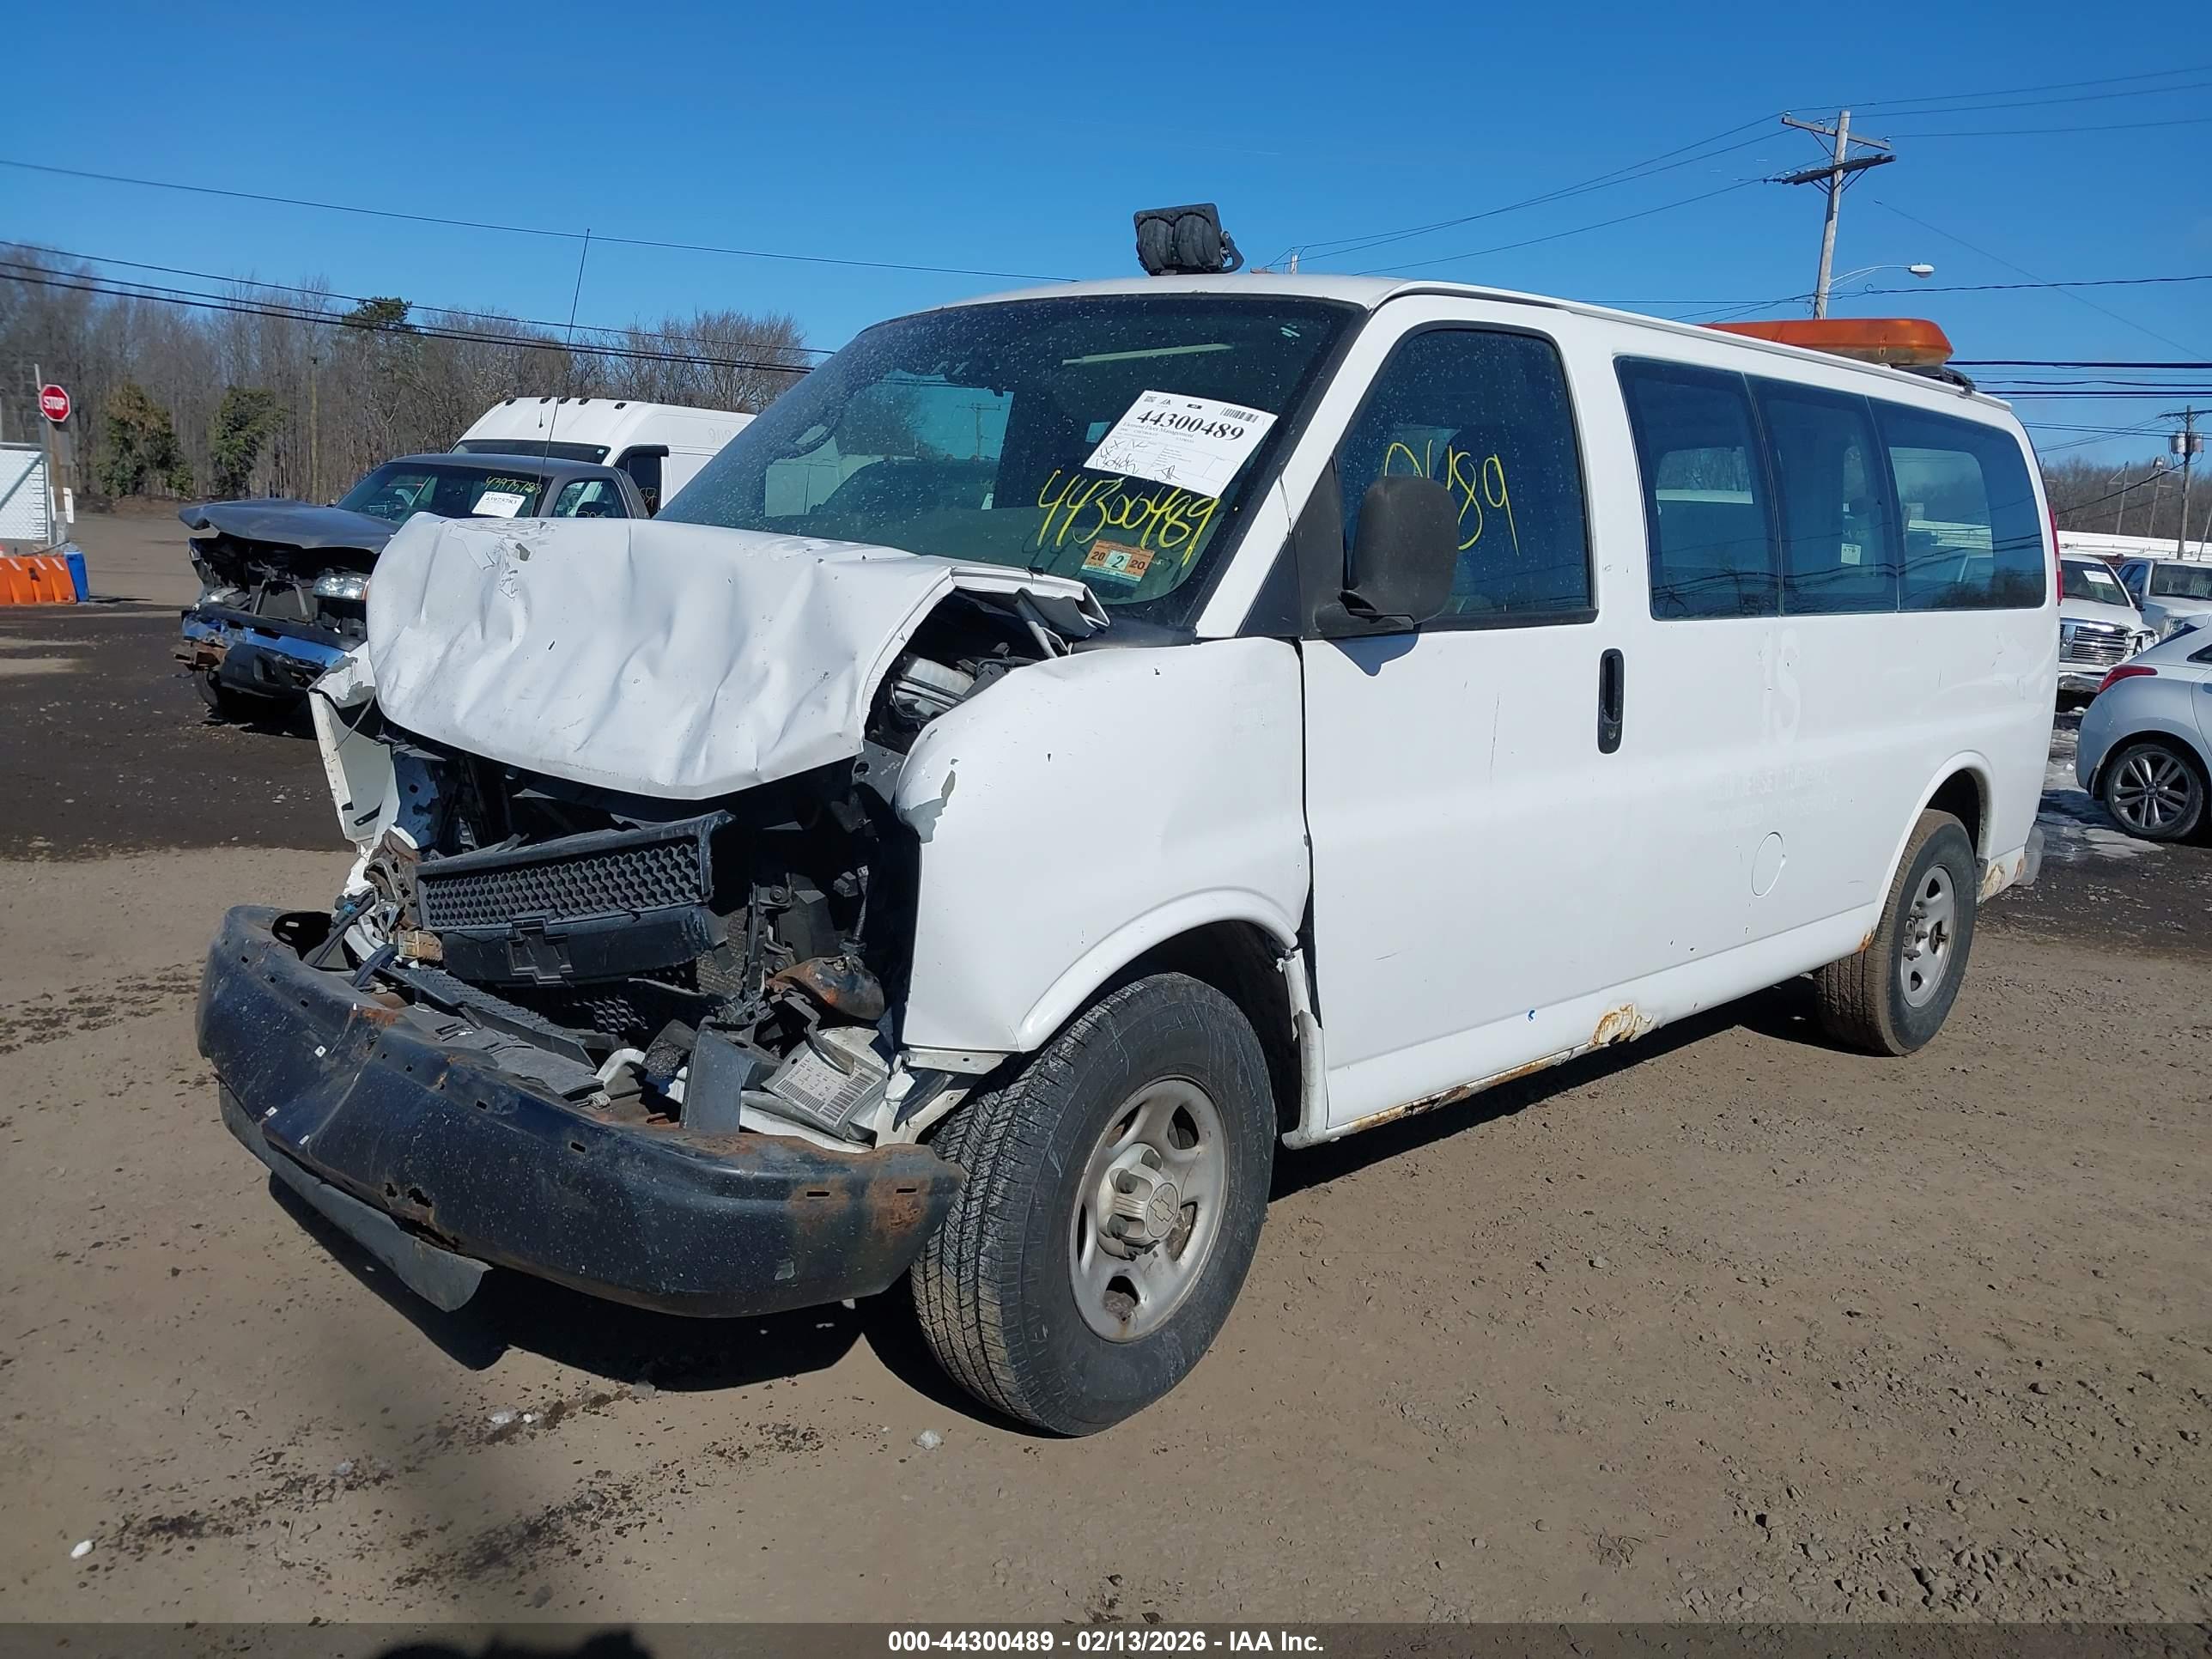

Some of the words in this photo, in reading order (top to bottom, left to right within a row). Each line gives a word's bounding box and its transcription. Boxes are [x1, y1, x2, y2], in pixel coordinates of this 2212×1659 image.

[44, 396, 66, 410] STOP
[1136, 410, 1245, 441] 44300489
[1036, 469, 1221, 568] 44300489
[1091, 550, 1106, 562] 20
[1111, 555, 1125, 568] 2
[1129, 559, 1146, 570] 20
